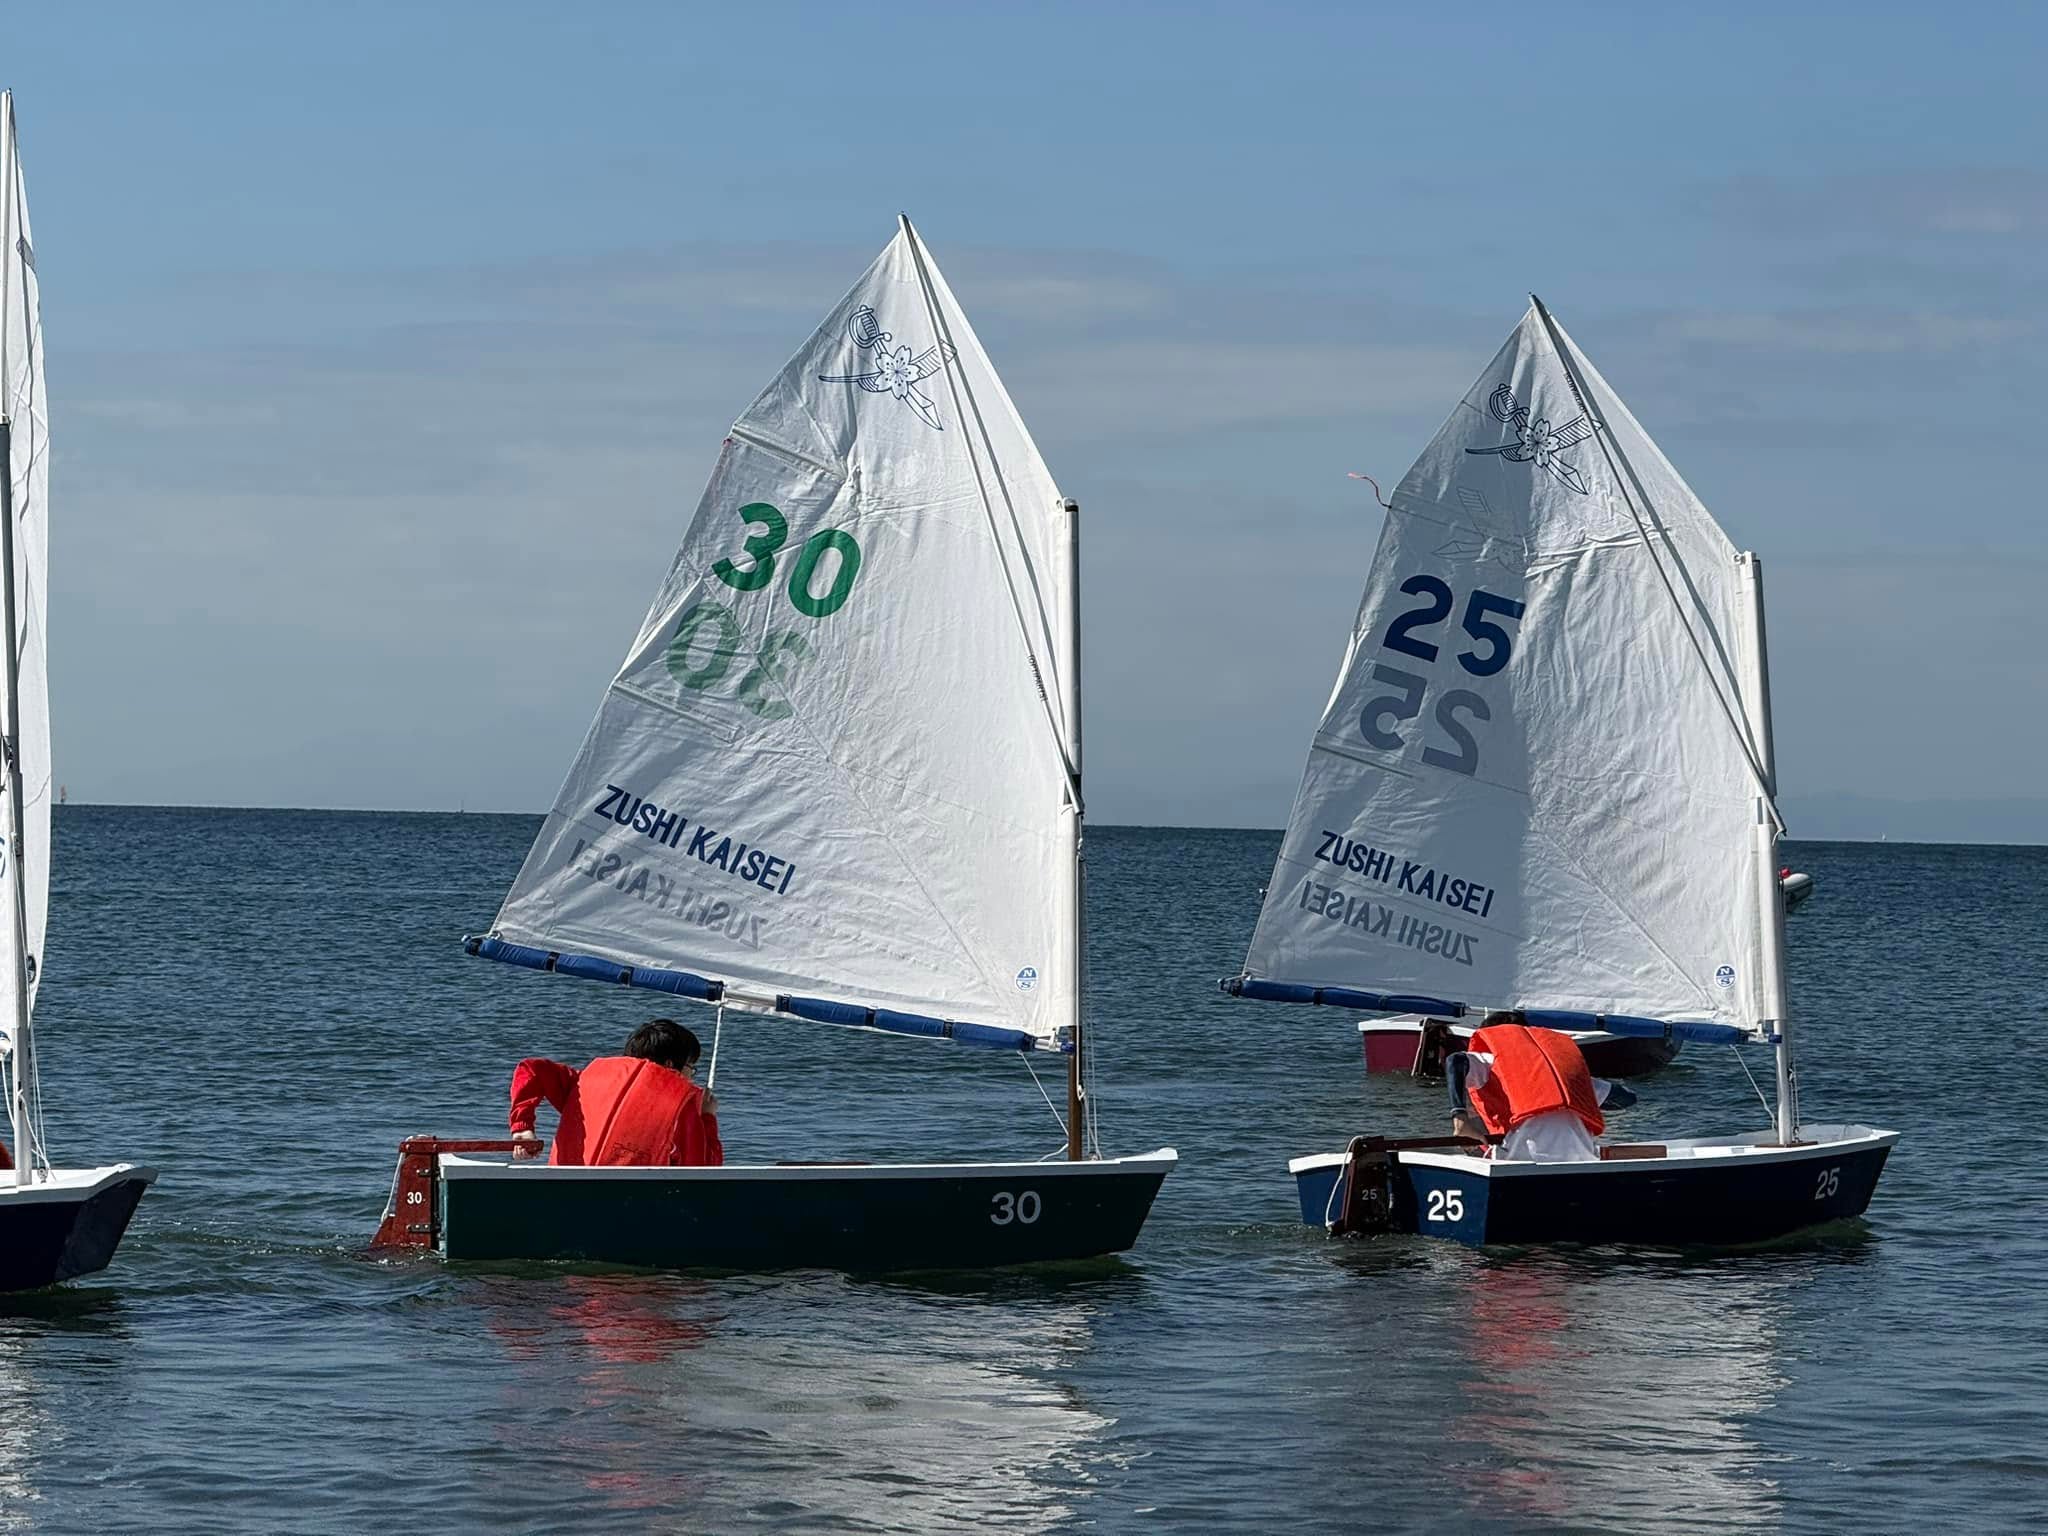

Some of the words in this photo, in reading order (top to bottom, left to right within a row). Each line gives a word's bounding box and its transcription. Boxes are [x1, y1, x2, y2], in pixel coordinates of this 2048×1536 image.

[712, 502, 861, 618] 30
[1383, 574, 1526, 677] 25
[594, 784, 689, 849] ZUSHI
[687, 825, 796, 895] KAISEI
[1314, 830, 1395, 883] ZUSHI
[1397, 861, 1495, 918] KAISEI
[406, 1191, 422, 1204] 30
[1362, 1188, 1378, 1200] 25
[1815, 1167, 1840, 1200] 25
[990, 1190, 1042, 1225] 30
[1427, 1189, 1464, 1222] 25
